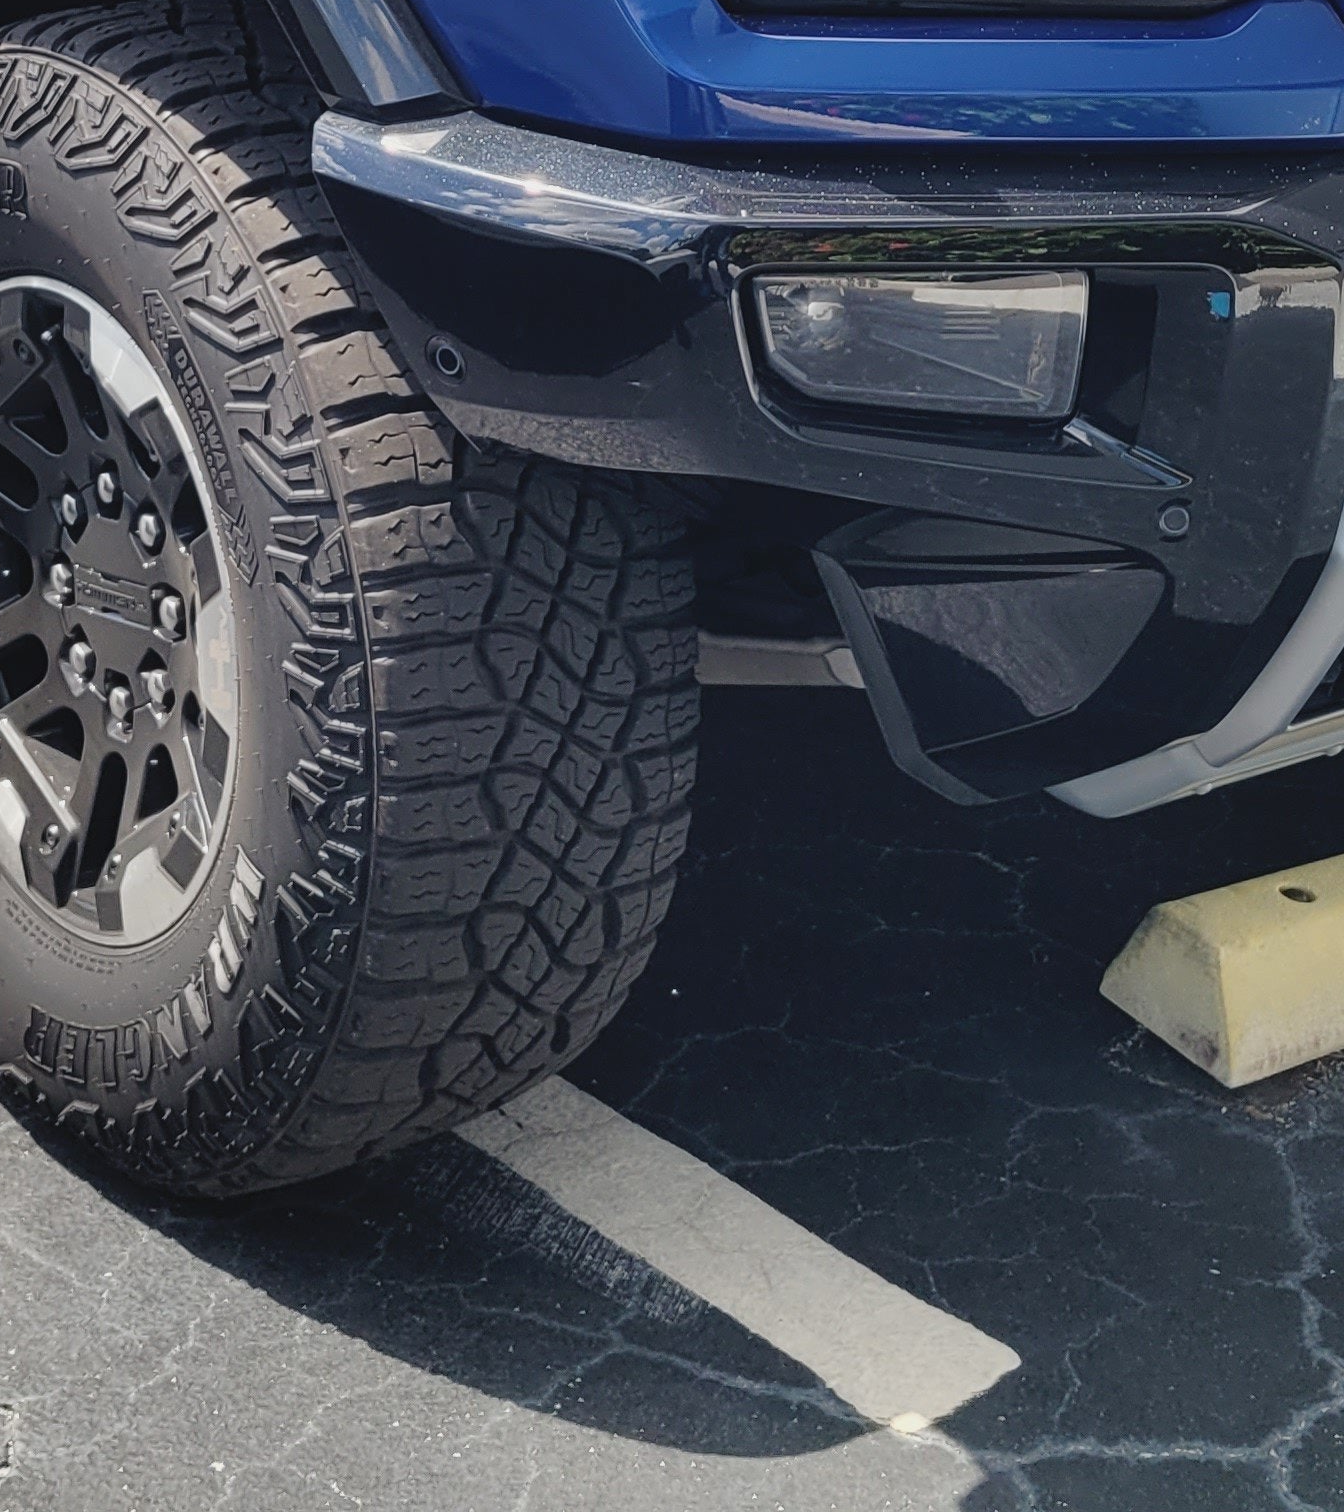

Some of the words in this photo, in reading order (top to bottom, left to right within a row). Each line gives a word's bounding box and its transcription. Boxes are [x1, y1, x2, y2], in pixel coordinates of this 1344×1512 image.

[173, 347, 239, 505] DURAWALL
[176, 374, 223, 490] TECHNOLOGY
[23, 843, 265, 1087] WRANGLER
